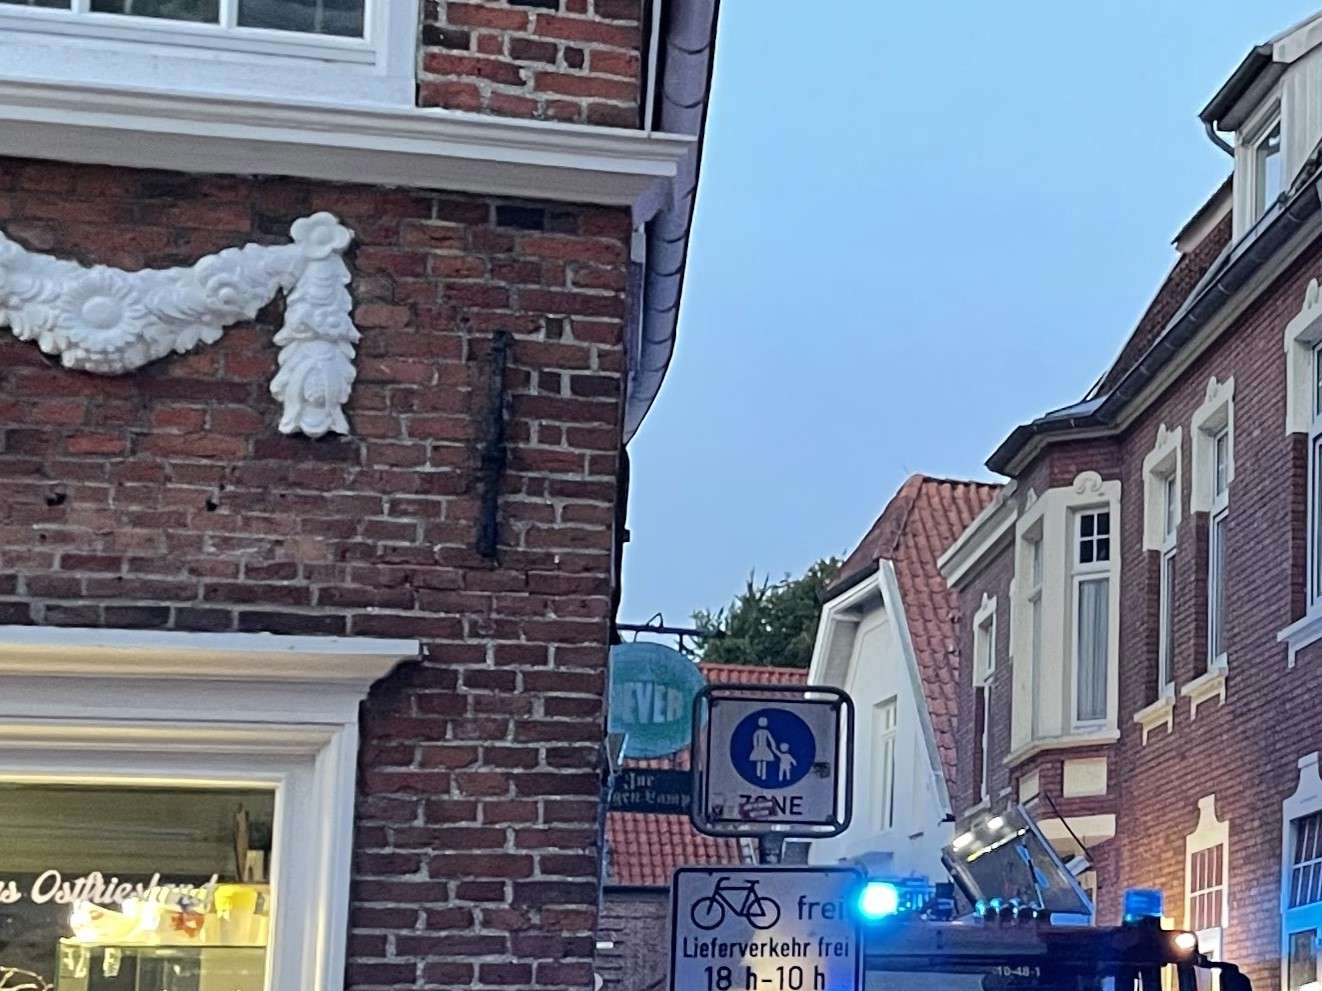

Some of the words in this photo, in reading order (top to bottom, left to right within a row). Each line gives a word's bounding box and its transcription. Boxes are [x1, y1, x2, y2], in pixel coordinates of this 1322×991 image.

[613, 682, 684, 723] EVER
[798, 894, 845, 920] frei
[682, 936, 811, 958] Lieferverkehr
[818, 936, 849, 957] frei
[704, 966, 732, 991] 18
[814, 966, 826, 990] h
